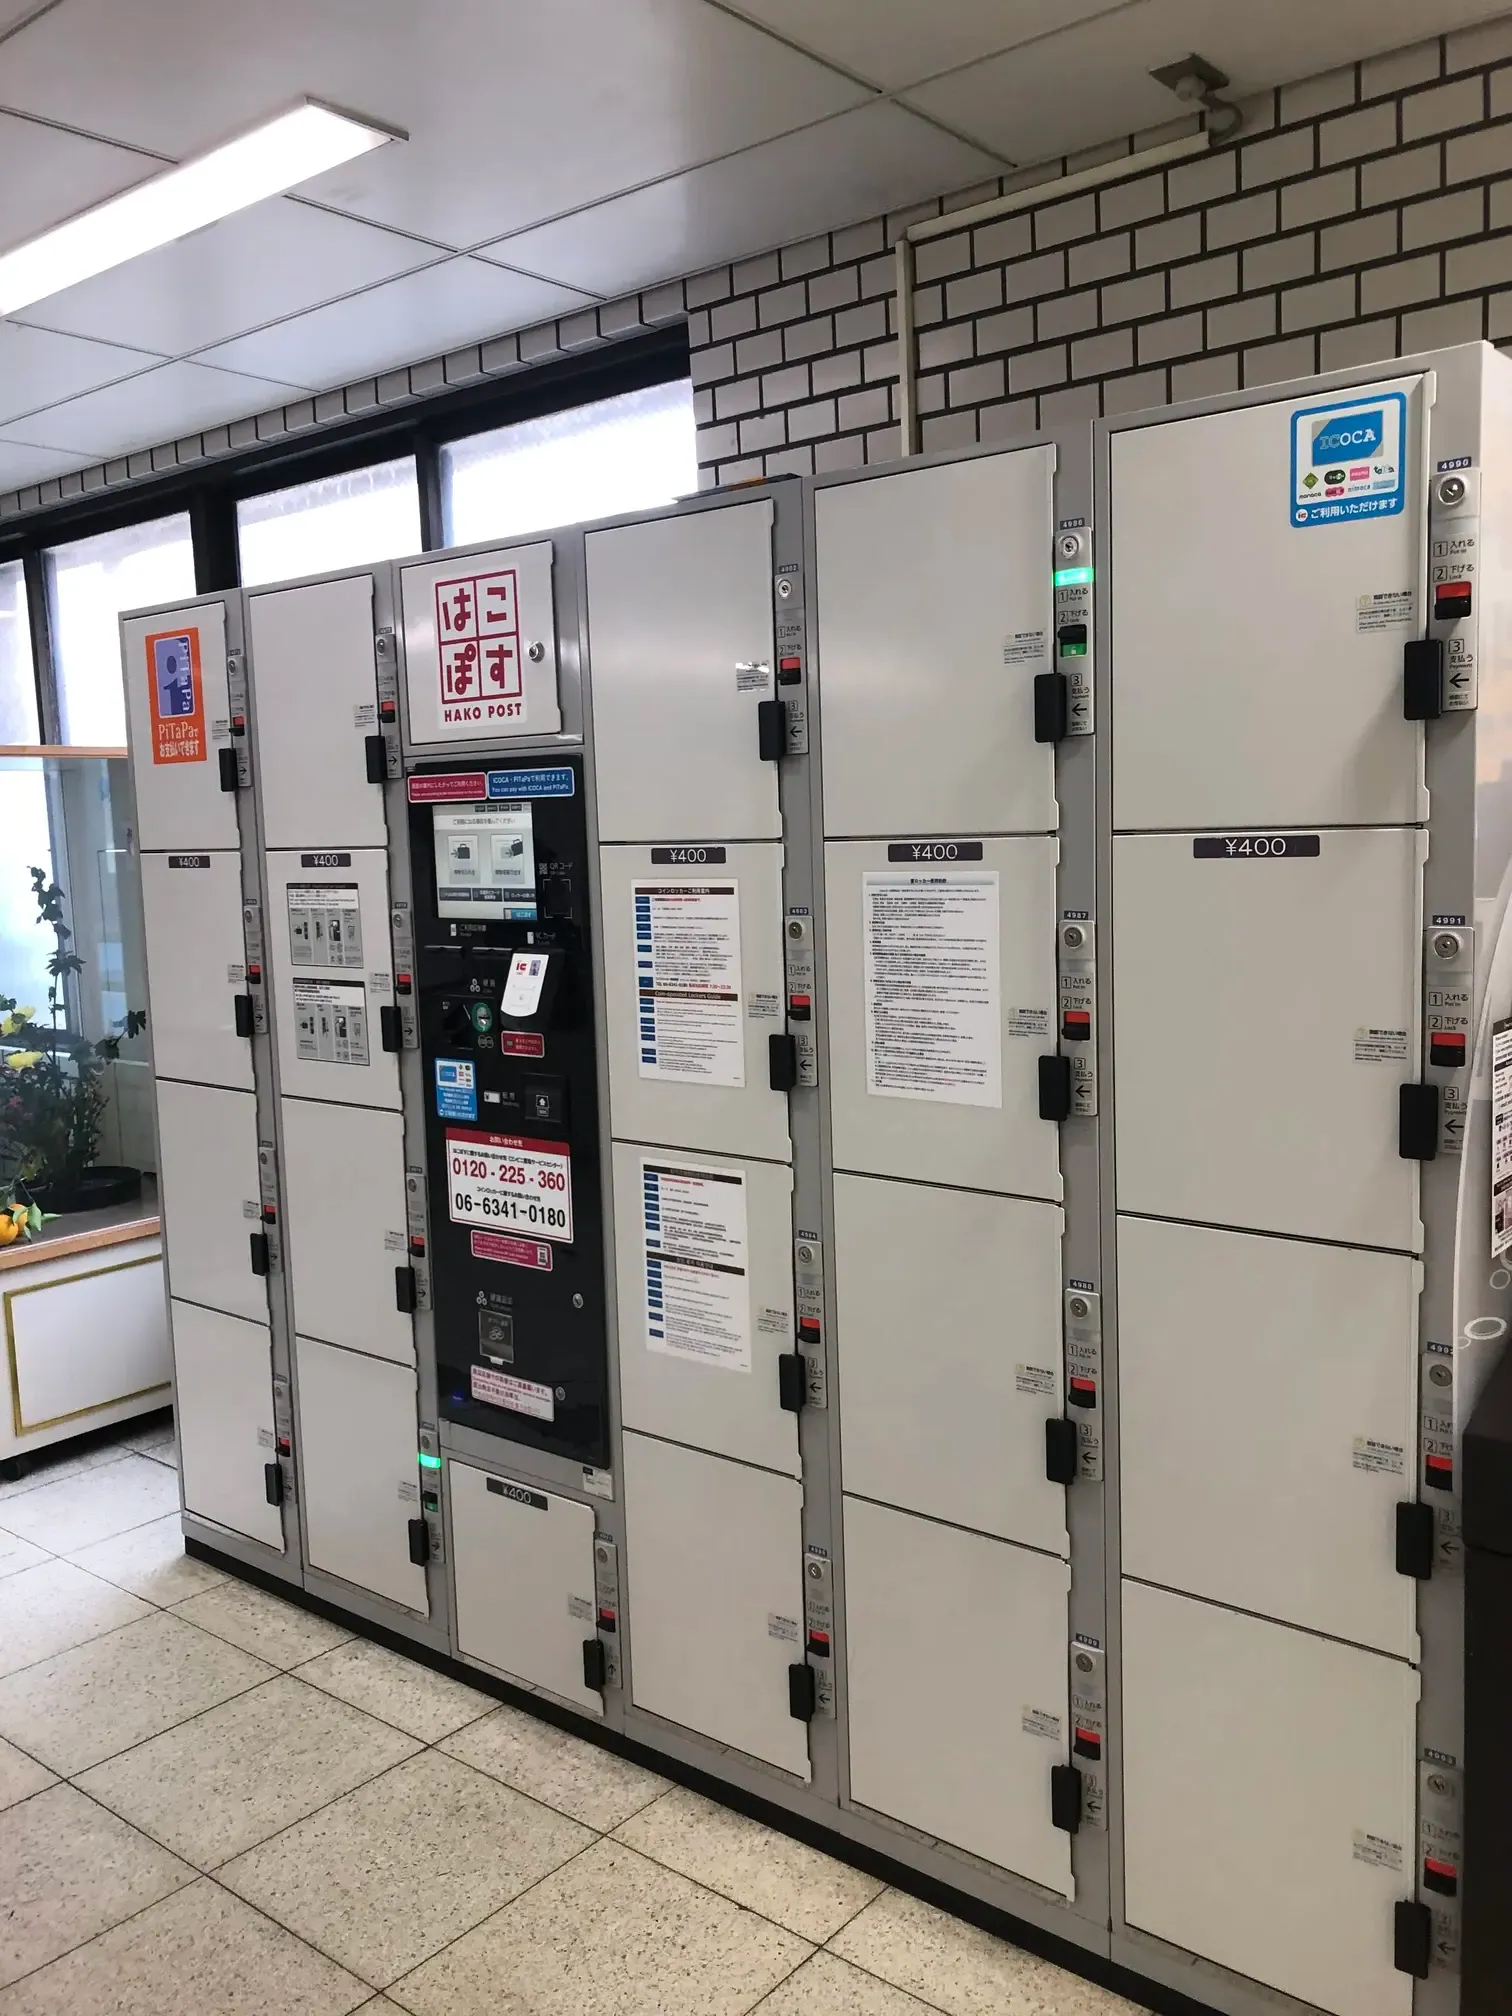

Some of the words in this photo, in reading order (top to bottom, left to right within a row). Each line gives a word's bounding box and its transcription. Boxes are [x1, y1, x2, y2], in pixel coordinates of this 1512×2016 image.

[1319, 428, 1376, 450] ICOCA
[1441, 459, 1469, 470] 4990
[1310, 497, 1398, 519] ご利用いただけます
[1449, 538, 1475, 549] 入れる
[1449, 563, 1475, 573] 下げる
[1069, 587, 1089, 596] 入れる
[442, 586, 508, 632] はこ
[1069, 609, 1089, 617] 下げる
[1449, 653, 1474, 663] 支払う
[446, 643, 514, 696] ぽす
[178, 640, 192, 711] PiTaPa
[444, 706, 482, 722] HAKO
[488, 702, 522, 719] POST
[911, 844, 958, 860] ¥400
[1225, 838, 1286, 856] ¥400
[312, 854, 339, 867] ¥400
[670, 848, 707, 863] ¥400
[178, 856, 200, 868] ¥400
[1066, 911, 1087, 919] 4987
[1435, 916, 1463, 925] 4991
[1072, 977, 1092, 985] 入れる
[654, 990, 687, 998] Coin-operated
[1444, 993, 1469, 1002] 入れる
[1072, 997, 1092, 1005] 下げる
[1444, 1016, 1469, 1025] 下げる
[489, 1135, 523, 1147] お問い合わせ先
[455, 1192, 566, 1228] 06-6341-0180
[1072, 1280, 1092, 1290] 4988
[502, 1483, 532, 1505] ¥400
